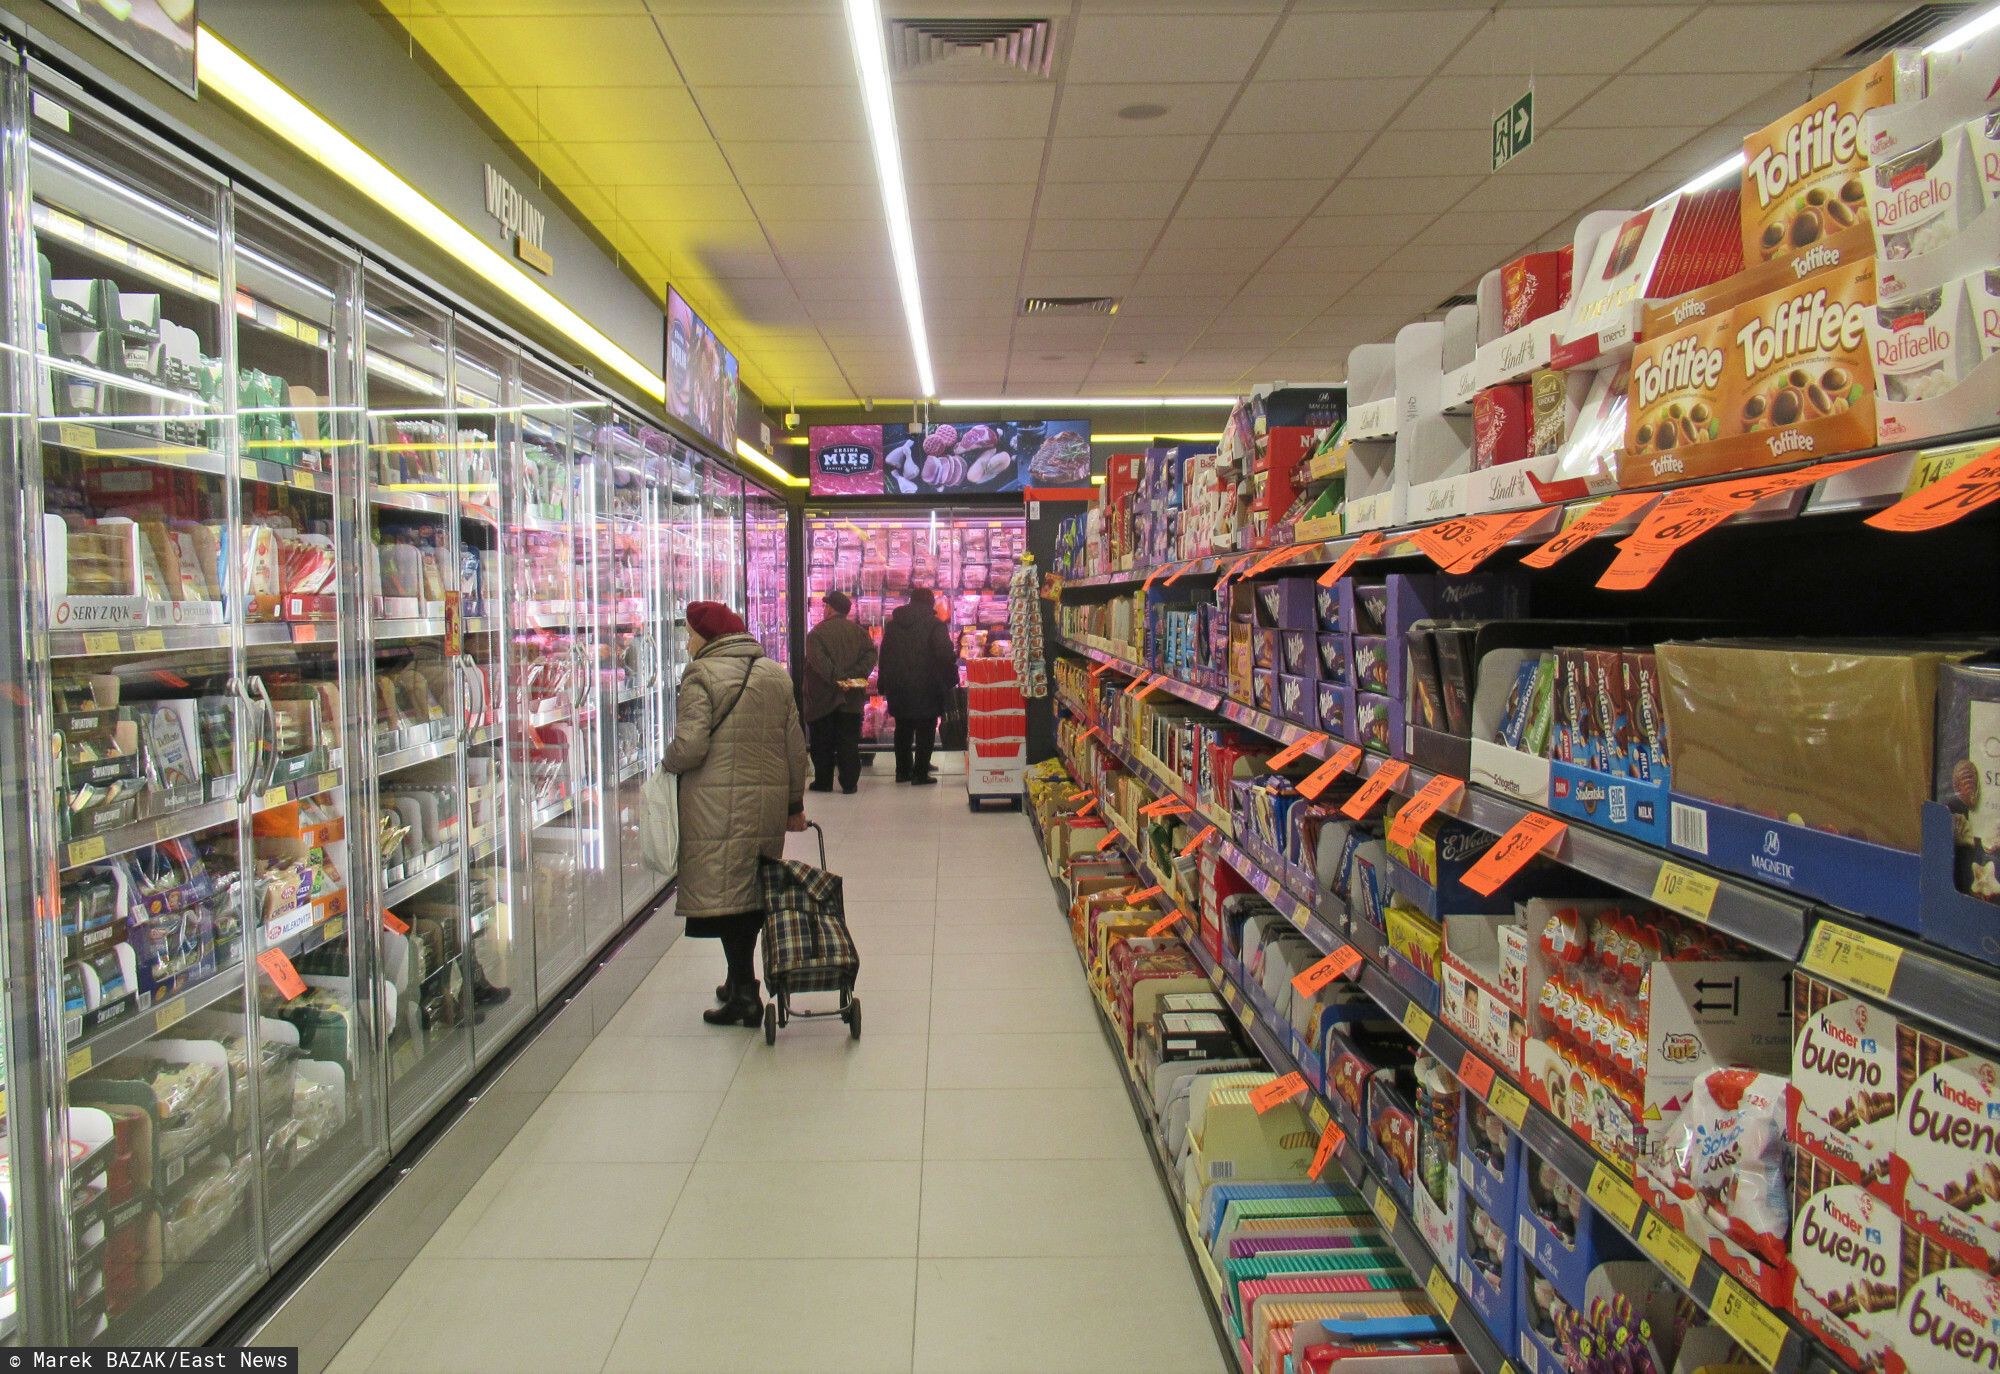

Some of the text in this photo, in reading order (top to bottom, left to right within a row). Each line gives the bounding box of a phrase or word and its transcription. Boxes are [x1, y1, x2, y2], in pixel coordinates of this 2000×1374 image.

[1875, 178, 1952, 228] Raffaello
[1790, 245, 1841, 280] Toffifee
[1672, 298, 1706, 325] Toffifee
[1602, 325, 1627, 344] merci
[1736, 290, 1867, 378] Toffifee
[1876, 326, 1949, 366] Raffaello
[1501, 339, 1528, 371] Lindt
[1634, 336, 1724, 408] Toffifee
[1766, 428, 1814, 458] Toffifee
[823, 453, 869, 466] MIĘS
[1650, 454, 1684, 477] Toffifee
[1488, 474, 1518, 501] Lindt
[1920, 460, 1944, 489] 14
[1426, 490, 1452, 511] Lindt
[1442, 584, 1484, 603] Milka
[72, 605, 130, 622] SERY Z RYK
[1562, 732, 1571, 762] DARK
[1640, 752, 1649, 779] MILK
[982, 775, 1014, 784] Raffaello
[1493, 773, 1520, 793] Schogetten
[1611, 787, 1624, 805] BIG
[1611, 805, 1626, 821] SIZE
[1638, 805, 1653, 820] MILK
[1495, 832, 1522, 861] 3
[1752, 853, 1795, 880] MAGNETIC
[1663, 873, 1677, 895] 10
[282, 912, 311, 933] MLEKOVITA
[1831, 940, 1842, 964] 7
[1821, 1013, 1859, 1049] kinder
[1801, 1027, 1882, 1086] bueno
[1933, 1072, 1984, 1114] kinder
[1909, 1087, 2000, 1154] buen
[1823, 1136, 1854, 1160] bueno
[1823, 1193, 1863, 1236] kinder
[1646, 1220, 1657, 1241] 2
[1802, 1205, 1886, 1276] bueno
[1938, 1215, 1979, 1246] bueno
[1724, 1292, 1735, 1316] 5
[1936, 1277, 1988, 1329] kinder
[1909, 1289, 2000, 1370] buen
